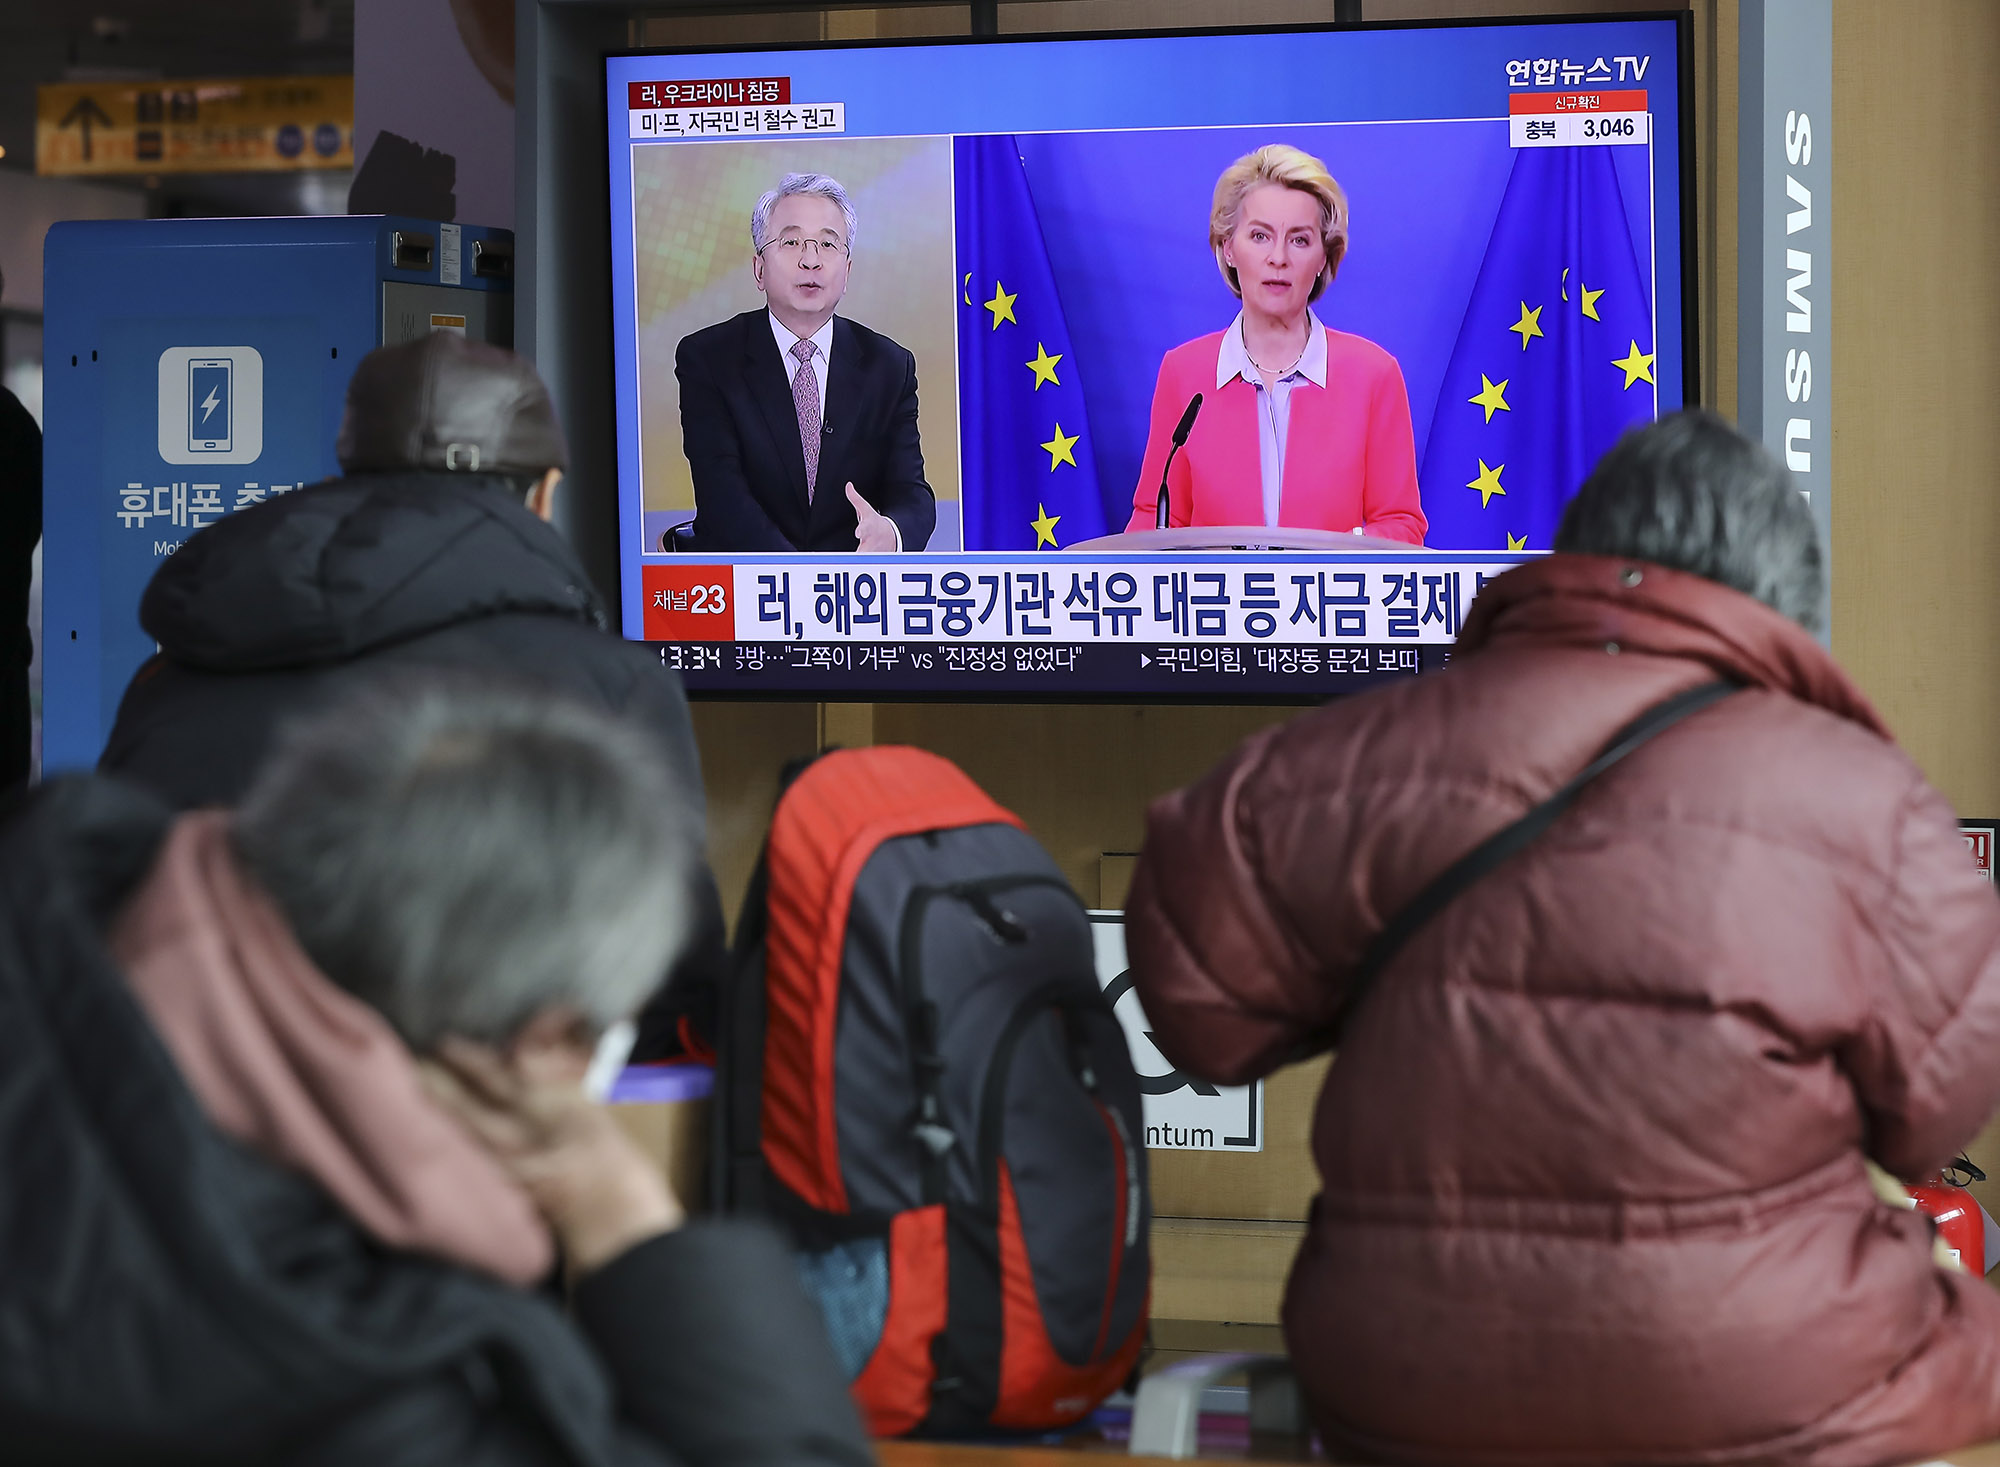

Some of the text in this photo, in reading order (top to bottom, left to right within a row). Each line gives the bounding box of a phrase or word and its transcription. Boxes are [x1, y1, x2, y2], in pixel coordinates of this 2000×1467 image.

[1505, 56, 1650, 87] 연합뉴스TV
[641, 81, 780, 107] 러, 우크라이나 침공
[688, 111, 739, 133] 자국민
[744, 111, 760, 132] 러
[763, 109, 798, 132] 철수
[801, 107, 836, 130] 권고
[1525, 120, 1557, 140] 충북
[1583, 118, 1635, 140] 3,046
[1785, 110, 1813, 505] SAMSU
[116, 482, 225, 528] 휴대폰
[757, 571, 804, 640] 러,
[812, 571, 888, 637] 해외
[898, 570, 1056, 638] 금융기관
[1064, 571, 1143, 637] 석유
[1152, 572, 1231, 637] 대금
[1239, 571, 1281, 638] 등
[1289, 572, 1371, 637] 자금
[1381, 572, 1461, 637] 결제
[660, 645, 722, 670] 13:34
[858, 646, 906, 671] 거부"
[911, 653, 934, 669] vs
[937, 646, 1007, 671] "진정성
[1013, 646, 1083, 672] 없었다"
[1155, 647, 1248, 675] 국민의힘,
[1326, 648, 1371, 673] 문건
[1146, 1122, 1215, 1148] ntum
